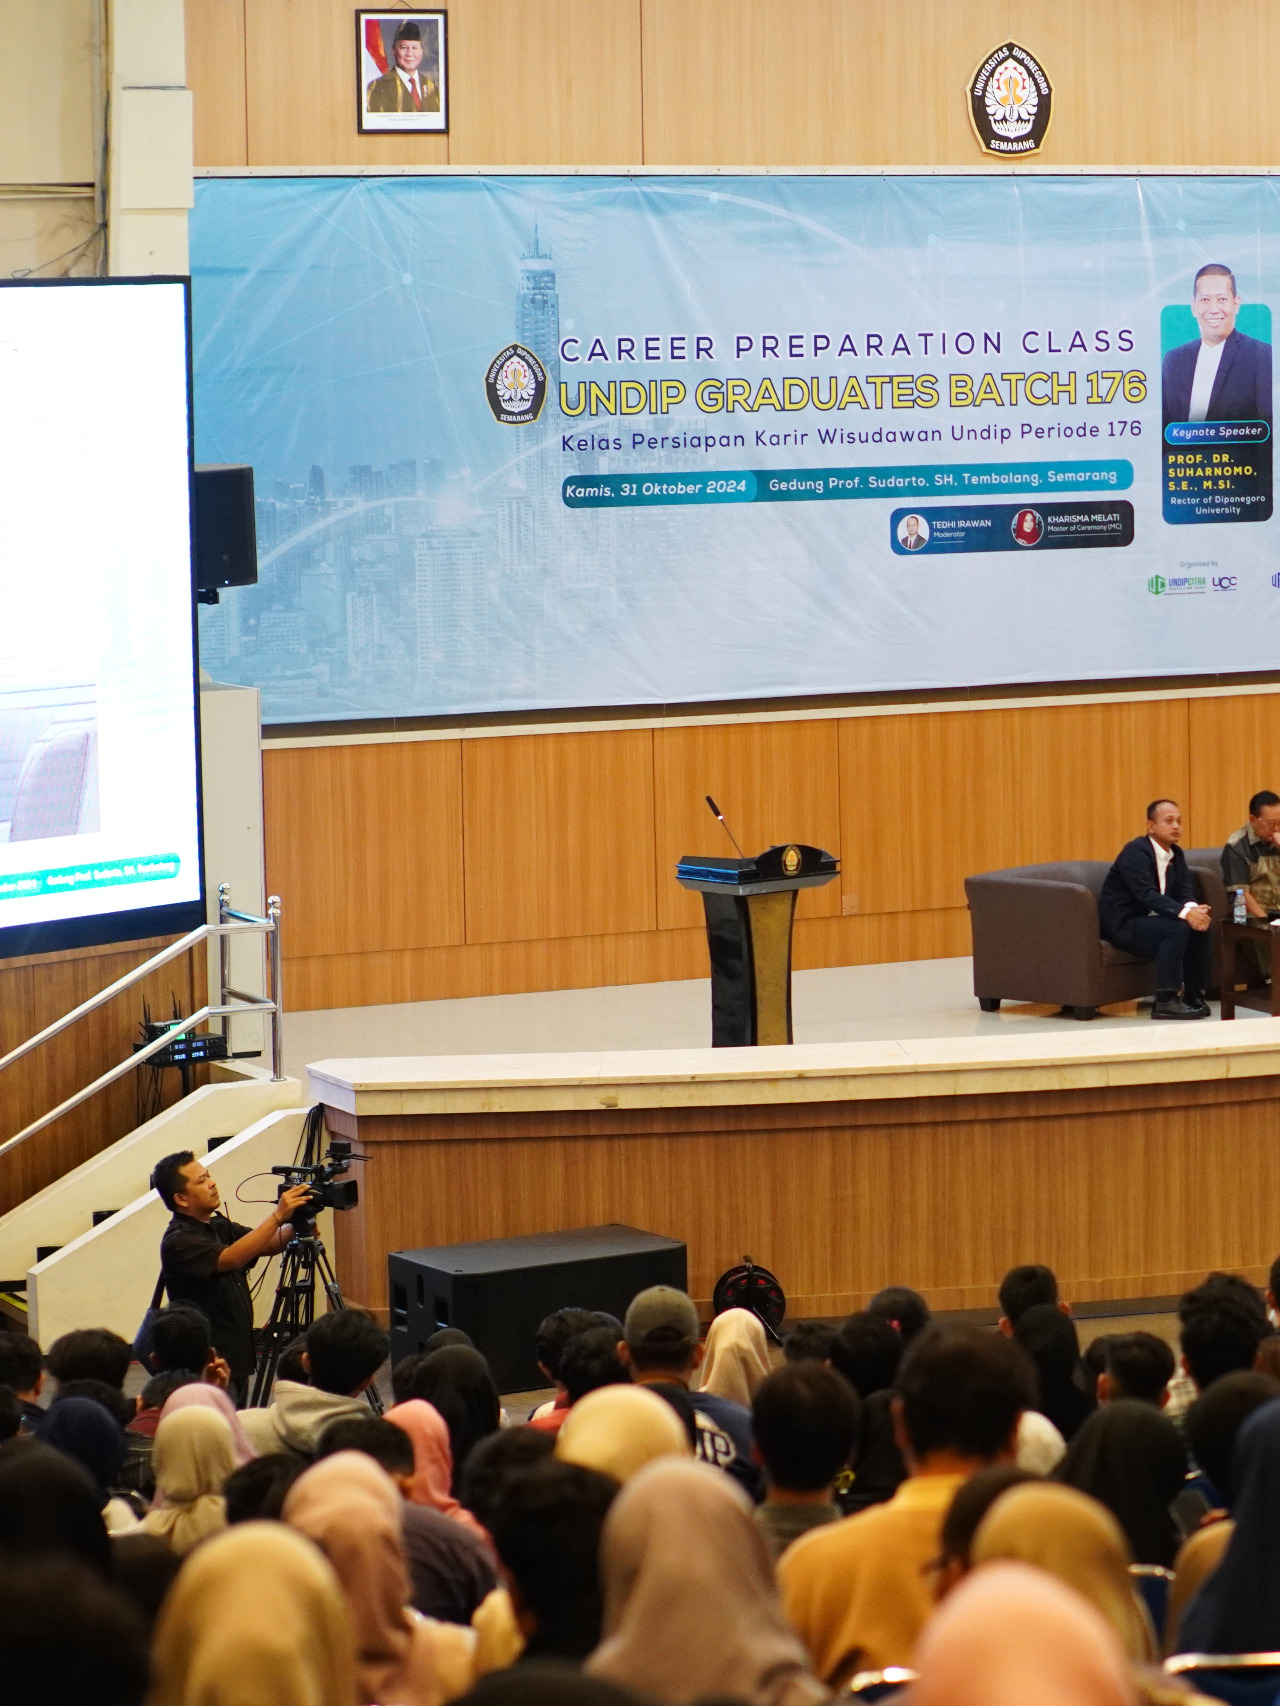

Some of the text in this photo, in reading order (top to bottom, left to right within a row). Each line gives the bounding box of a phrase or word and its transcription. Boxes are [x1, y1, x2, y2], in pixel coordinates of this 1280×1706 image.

[974, 46, 1049, 96] UNIVERSITAS DIPONEGORO
[990, 140, 1035, 150] SEMARANG
[560, 330, 1134, 362] CAREER PREPARATION CLASS
[488, 347, 544, 383] UNIVERSITAS DIPONEGORO
[560, 370, 1147, 417] UNDIP GRADUATES BATCH 176
[500, 413, 534, 422] SEMARANG
[562, 420, 1142, 452] Kelas Persiapan Karir Wisudawan Undip Periode 176
[1173, 426, 1262, 439] Keynote Speaker
[1168, 454, 1234, 464] PROF. DR.
[769, 478, 824, 492] Gedung
[829, 476, 864, 489] Prof.
[1048, 470, 1118, 484] Semarang
[1203, 480, 1235, 490] M.SI.
[566, 480, 746, 498] Kamis, 31 Oktober 2024
[1170, 495, 1266, 504] Rector of Diponegoro
[1196, 506, 1241, 515] University
[1048, 514, 1120, 524] KHARISMA MELATI
[932, 520, 992, 529] TEDHI IRAWAN
[1070, 524, 1077, 532] of
[934, 530, 966, 538] Moderator
